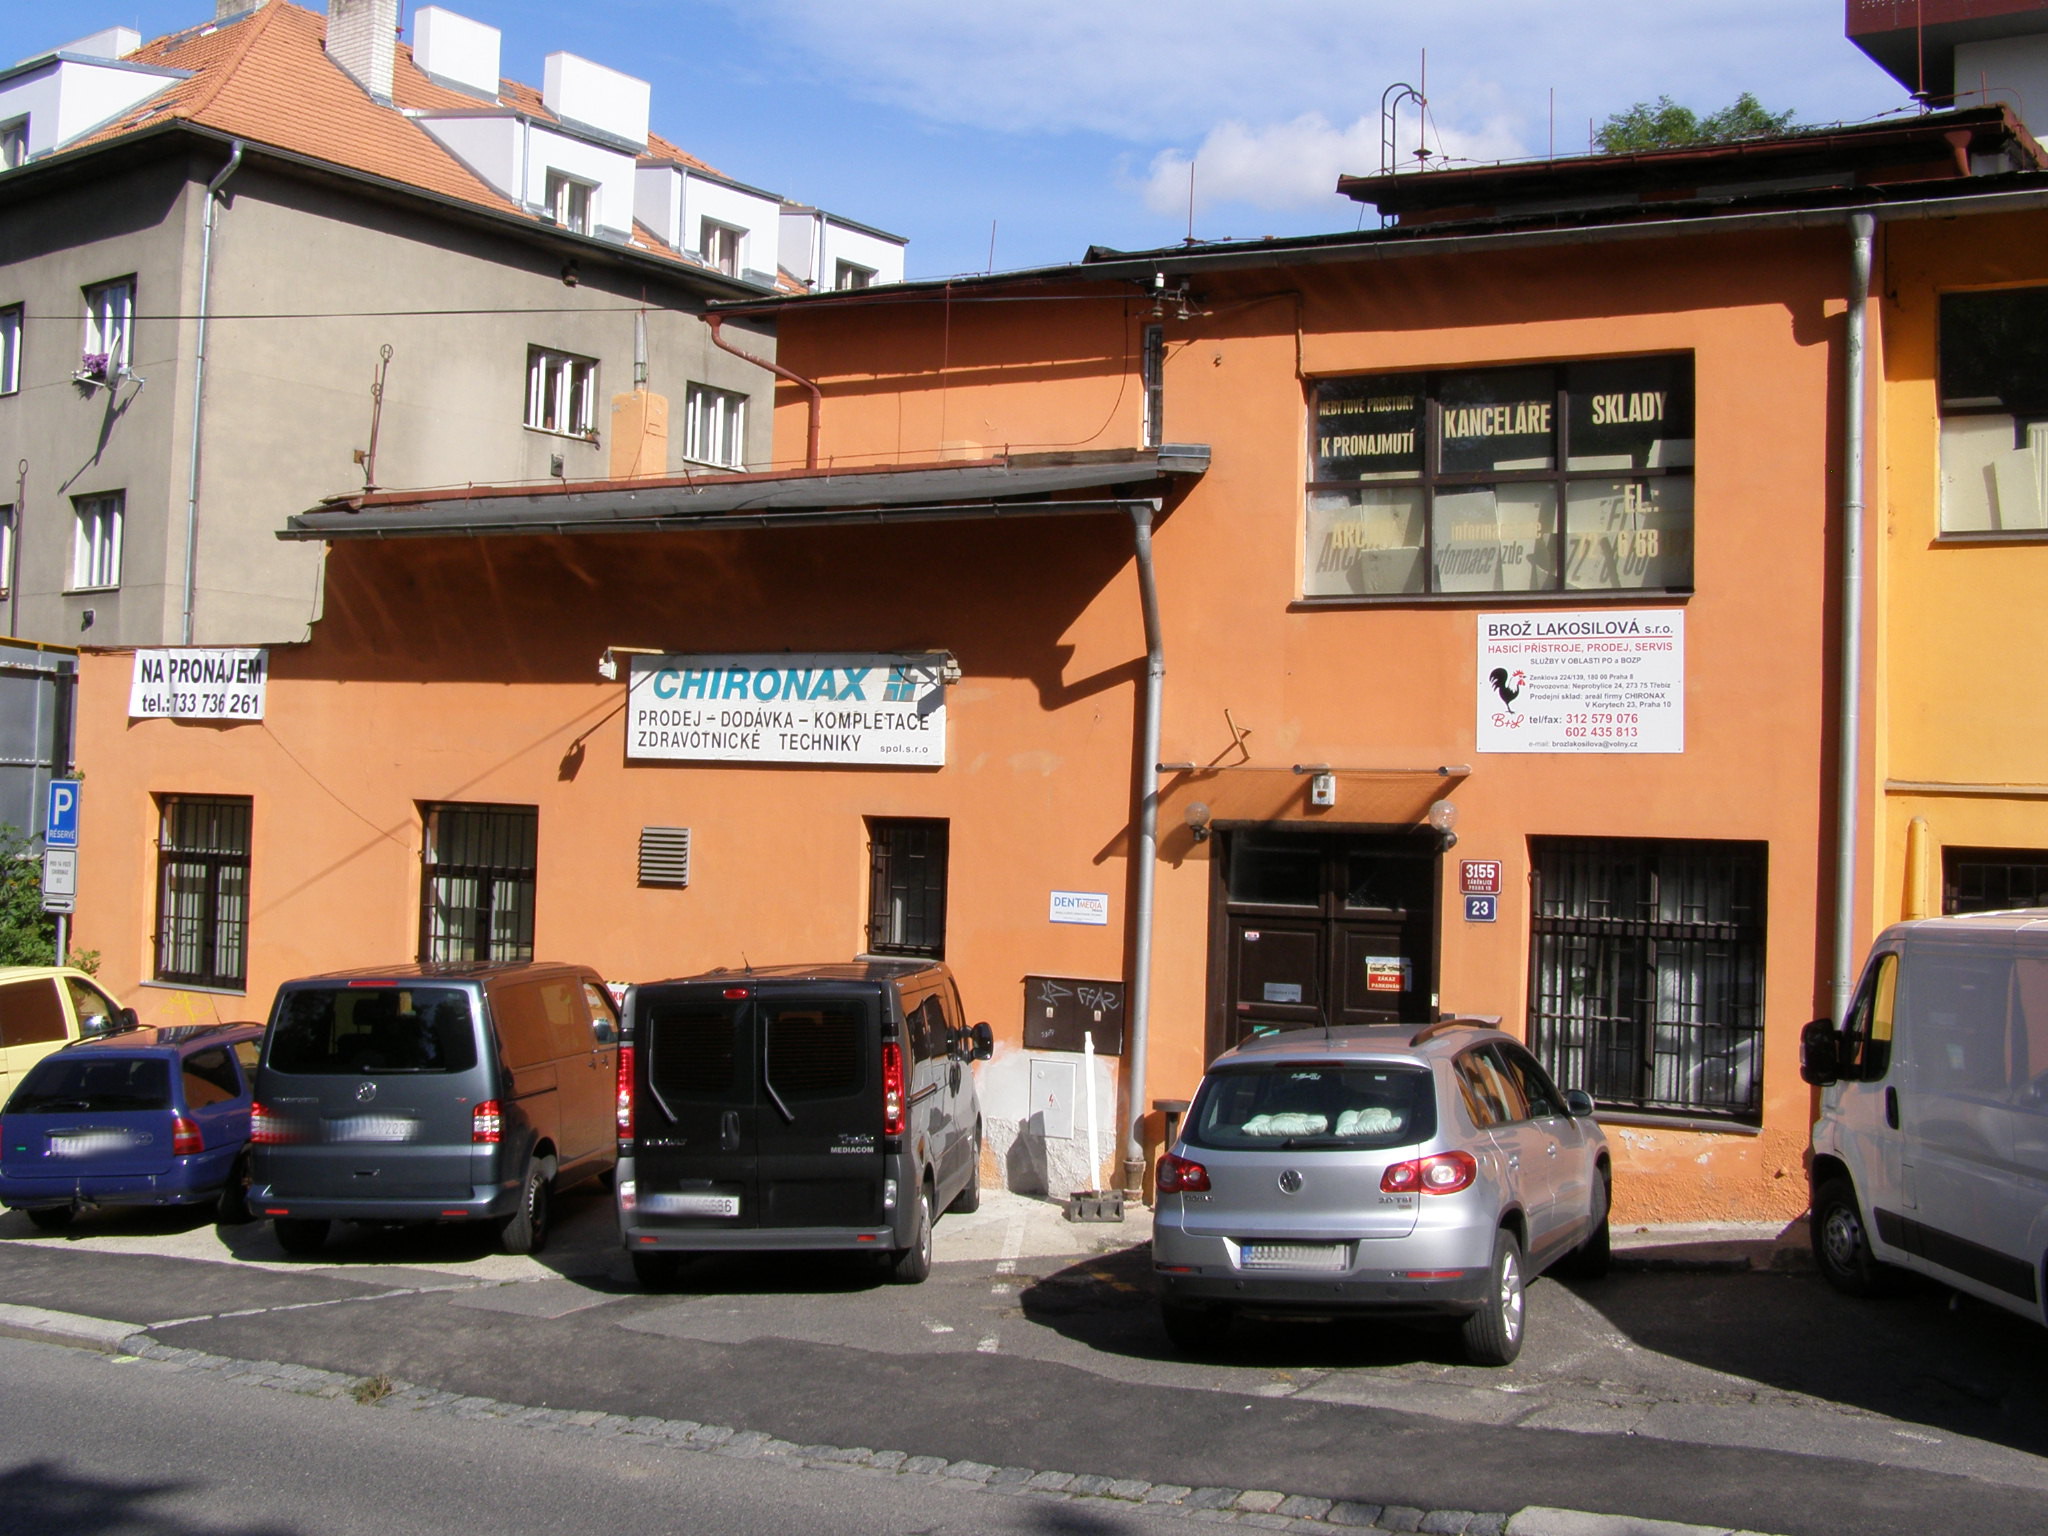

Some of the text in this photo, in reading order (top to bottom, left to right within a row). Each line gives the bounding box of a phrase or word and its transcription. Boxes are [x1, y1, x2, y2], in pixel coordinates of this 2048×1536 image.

[1319, 395, 1415, 416] NEBYTOVÉ PROSTORY
[1592, 391, 1667, 425] SKLADY
[1444, 400, 1552, 439] KANCELÁŘE
[1321, 428, 1415, 457] K PRONAJMUTÍ
[1488, 618, 1674, 637] BROŽ LAKOSILOVÁ s.r.o.
[1488, 641, 1673, 655] HASICÍ PŘÍSTROJE, PRODEJ, SERVIS
[141, 652, 262, 684] NA PRONÁJEM
[1530, 656, 1559, 665] SLUŽBY
[1567, 657, 1600, 665] OBLASTI
[1620, 656, 1642, 664] BOZP
[652, 665, 873, 702] CHIRONAX
[1572, 682, 1613, 690] Neprobylice
[202, 693, 225, 713] 736
[229, 694, 259, 714] 261
[1585, 692, 1603, 700] areál
[1604, 692, 1623, 701] firmy
[1592, 701, 1625, 710] Korytech
[1626, 701, 1638, 709] 23,
[638, 709, 702, 727] PRODEJ
[721, 707, 794, 729] DODÁVKA
[814, 711, 930, 731] KOMPLETACE
[1529, 713, 1638, 724] tel/fax: 312 579 076
[1565, 726, 1638, 737] 602 435 813
[638, 729, 862, 752] ZDRAVOTNICKÉ TECHNIKY
[1551, 740, 1639, 749] brozlakosilova@volny.cz
[1465, 863, 1496, 879] 3155
[1471, 900, 1489, 916] 23
[830, 1146, 875, 1154] MEDIACOM
